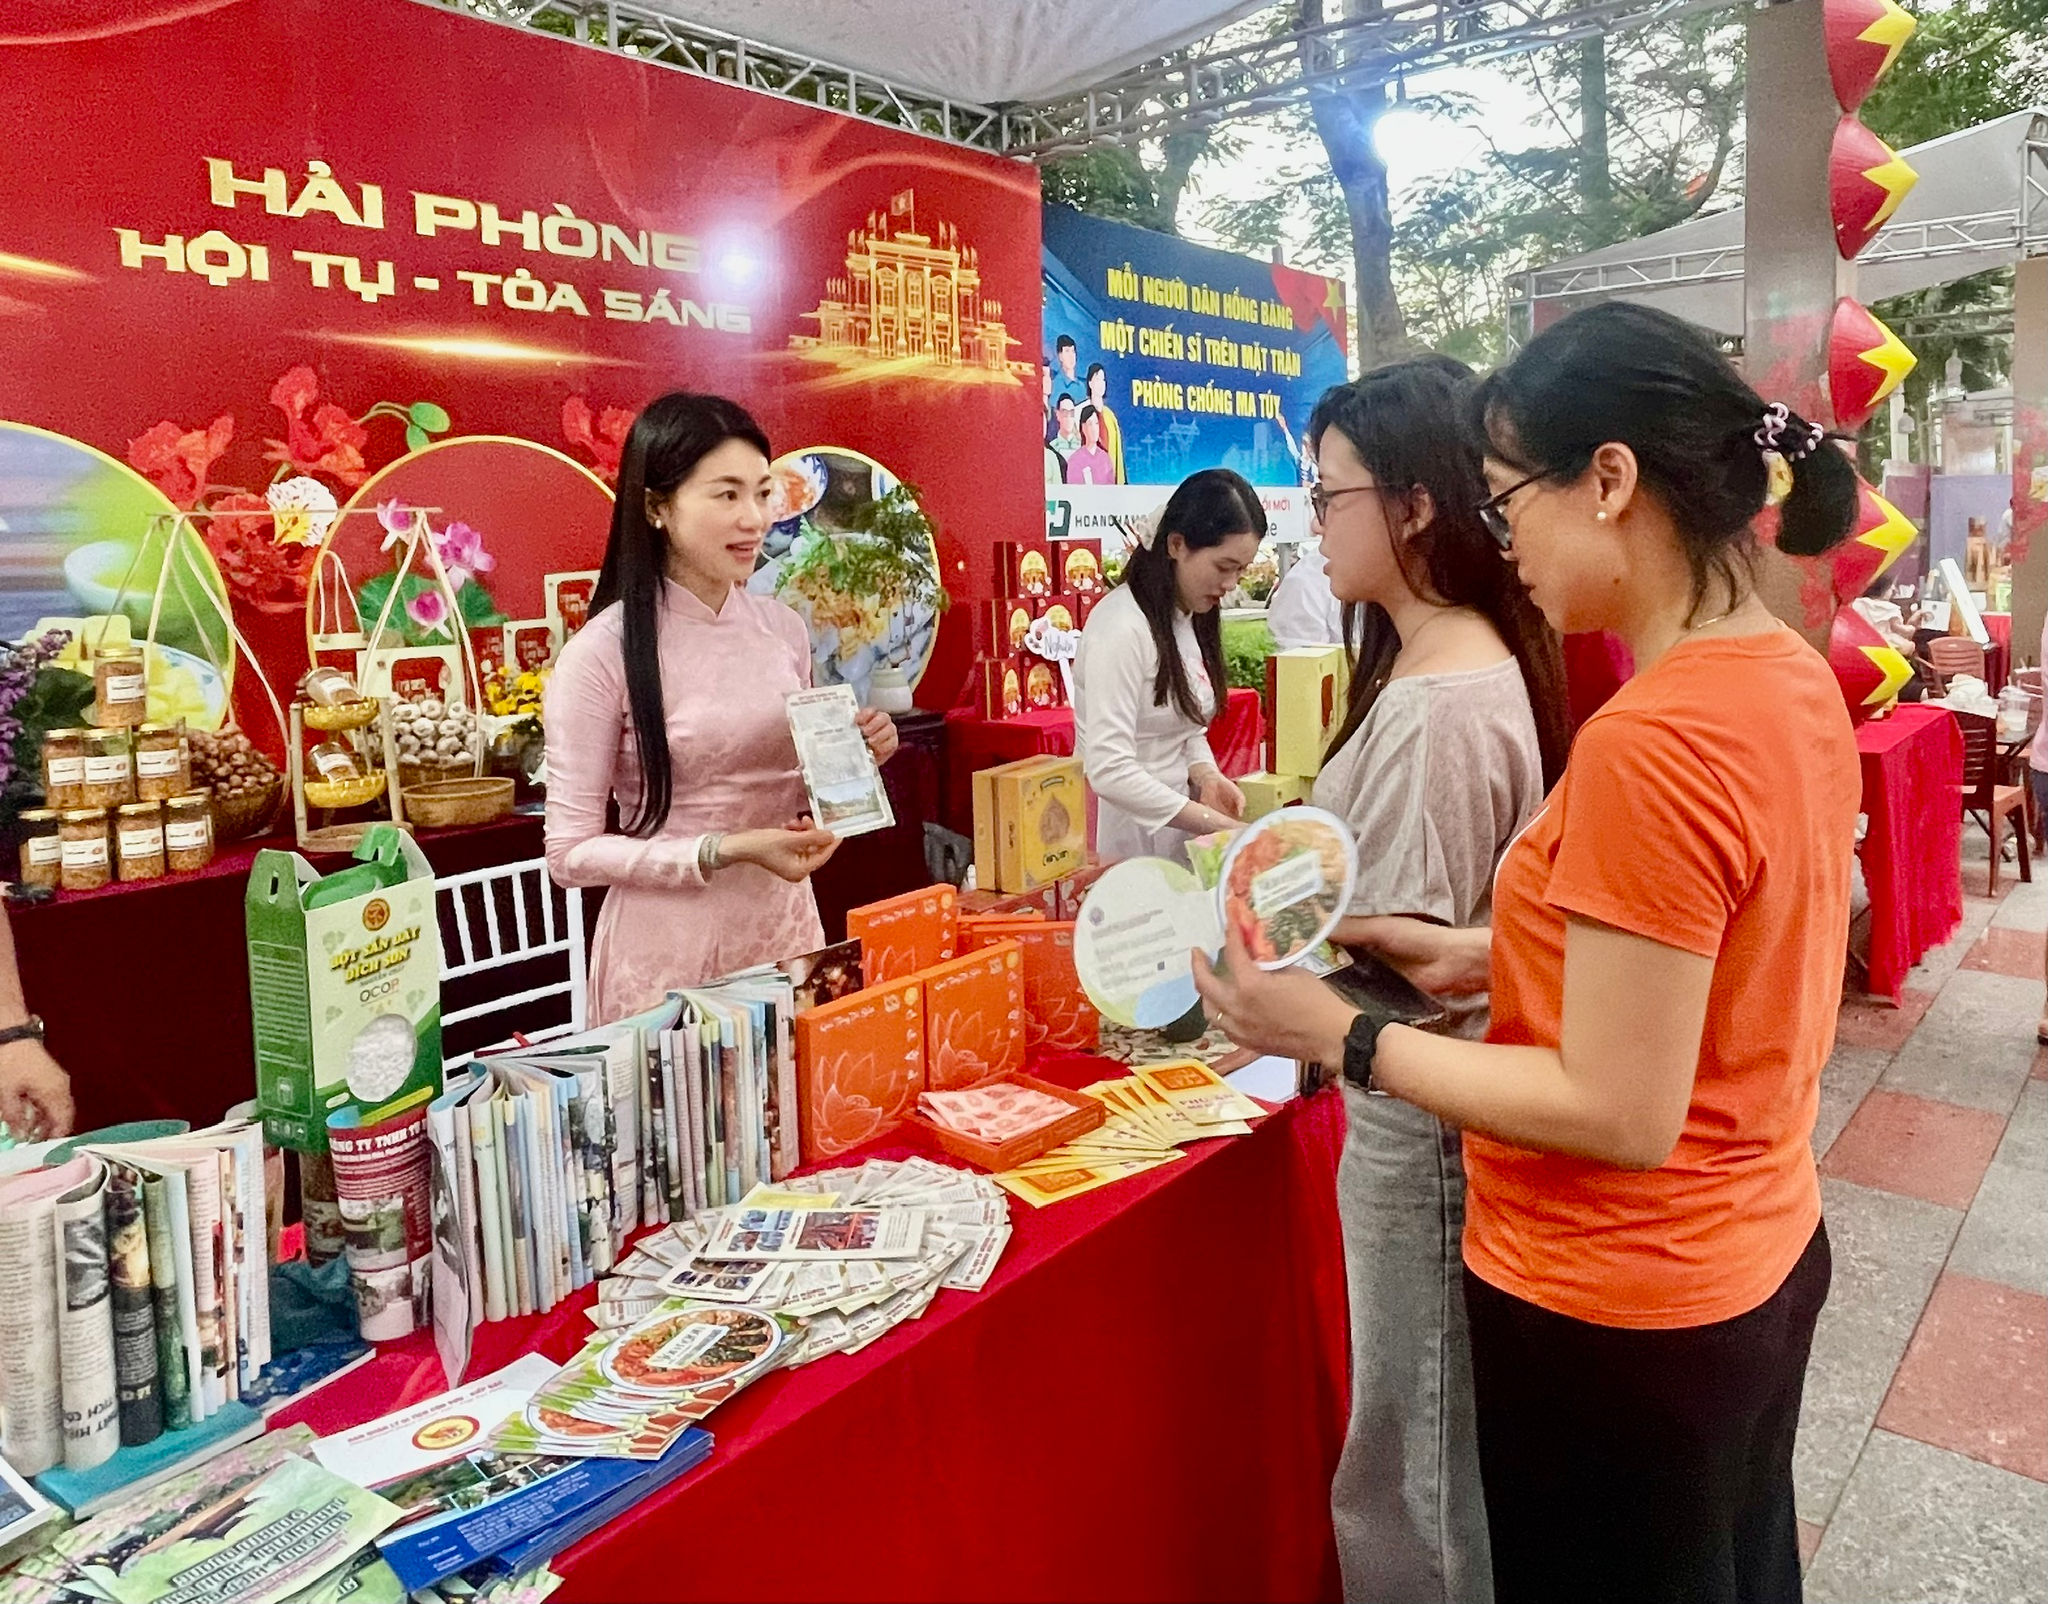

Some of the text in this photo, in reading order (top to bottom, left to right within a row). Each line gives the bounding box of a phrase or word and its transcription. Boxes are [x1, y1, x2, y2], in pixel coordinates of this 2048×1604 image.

[203, 157, 704, 273] HẢI PHÒNG
[112, 227, 751, 334] HỘI TỤ - TỎA SÁNG
[1107, 261, 1140, 302] MỖI
[1142, 275, 1189, 312] NGƯỜI
[1192, 282, 1221, 317] DÂN
[1223, 286, 1259, 324] HỒNG
[1100, 317, 1301, 381] MỘT CHIẾN SĨ TRÊN MẶT TRẬN
[1132, 375, 1282, 420] PHÒNG CHỐNG MA TÚY
[360, 978, 399, 1003] OCOP
